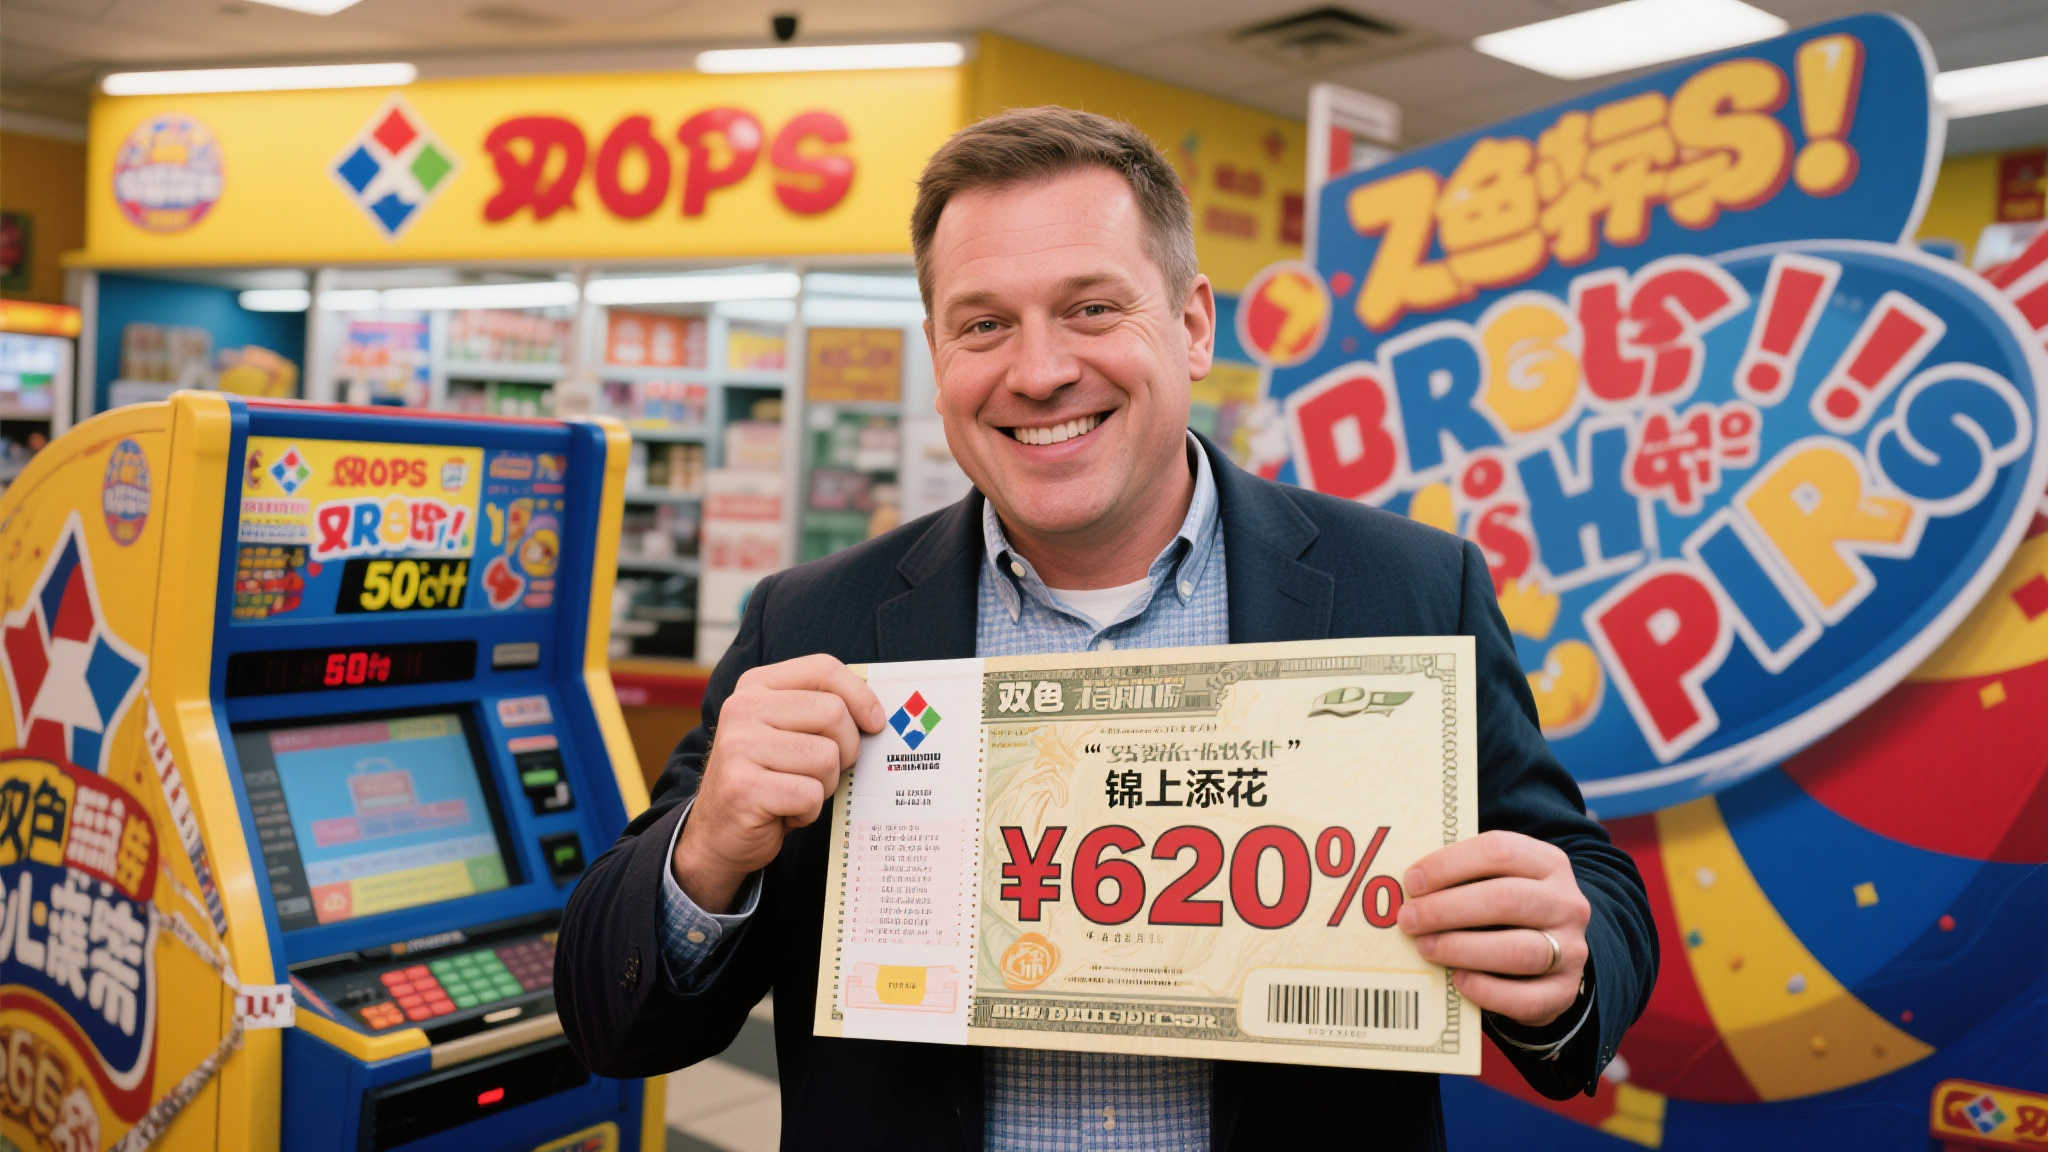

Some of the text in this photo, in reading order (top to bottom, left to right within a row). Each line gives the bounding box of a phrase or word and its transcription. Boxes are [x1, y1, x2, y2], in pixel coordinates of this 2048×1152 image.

[998, 680, 1064, 714] 双色
[1105, 767, 1269, 809] 锦上添花
[999, 824, 1405, 931] ¥620%
